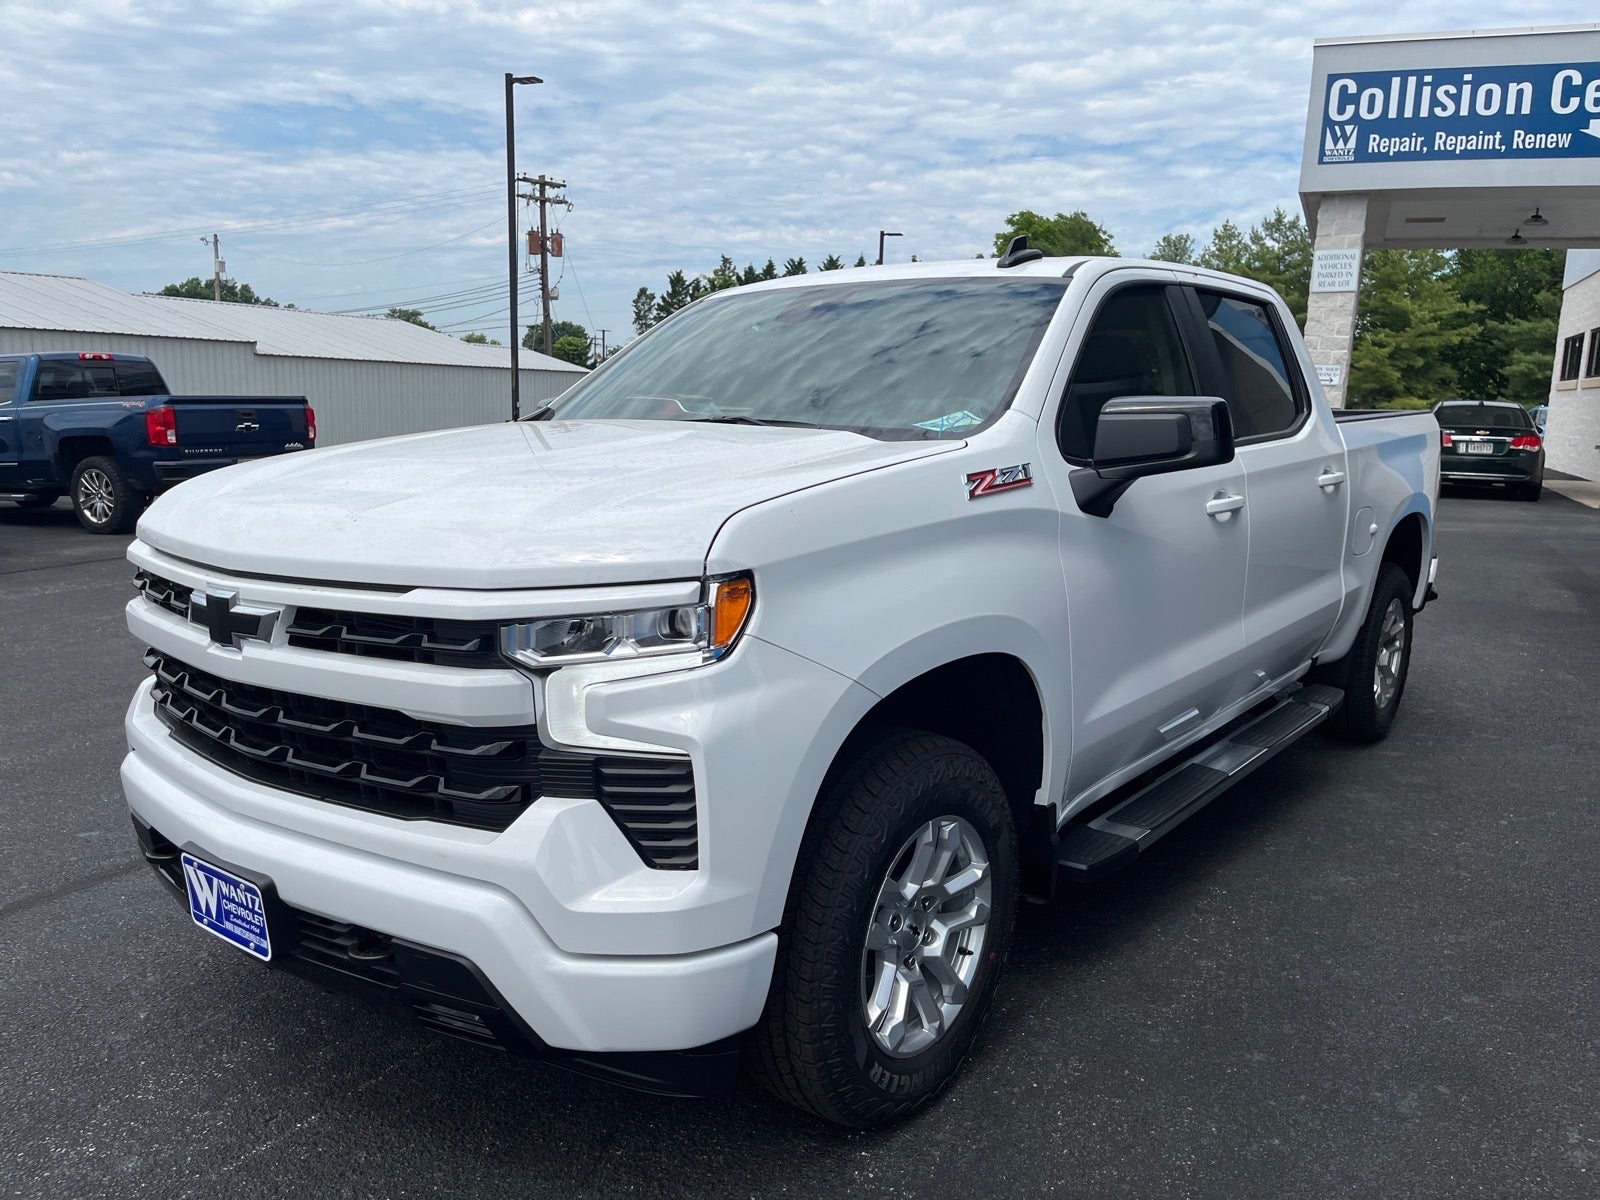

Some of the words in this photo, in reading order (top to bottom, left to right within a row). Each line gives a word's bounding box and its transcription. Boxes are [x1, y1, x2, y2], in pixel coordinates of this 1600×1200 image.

[1328, 73, 1533, 122] Collision
[1368, 132, 1428, 156] Repair,
[1434, 130, 1506, 154] Repaint,
[1512, 129, 1572, 149] Renew
[1325, 148, 1355, 156] WANTZ
[1316, 253, 1356, 261] ADDITIONAL
[1319, 262, 1352, 270] VEHICLES
[1317, 271, 1344, 279] PARKED
[1318, 280, 1336, 288] REAR
[1338, 279, 1350, 287] LOT
[961, 462, 1035, 501] Z71
[218, 879, 263, 914] WANTZ
[222, 898, 264, 927] CHEVROLET
